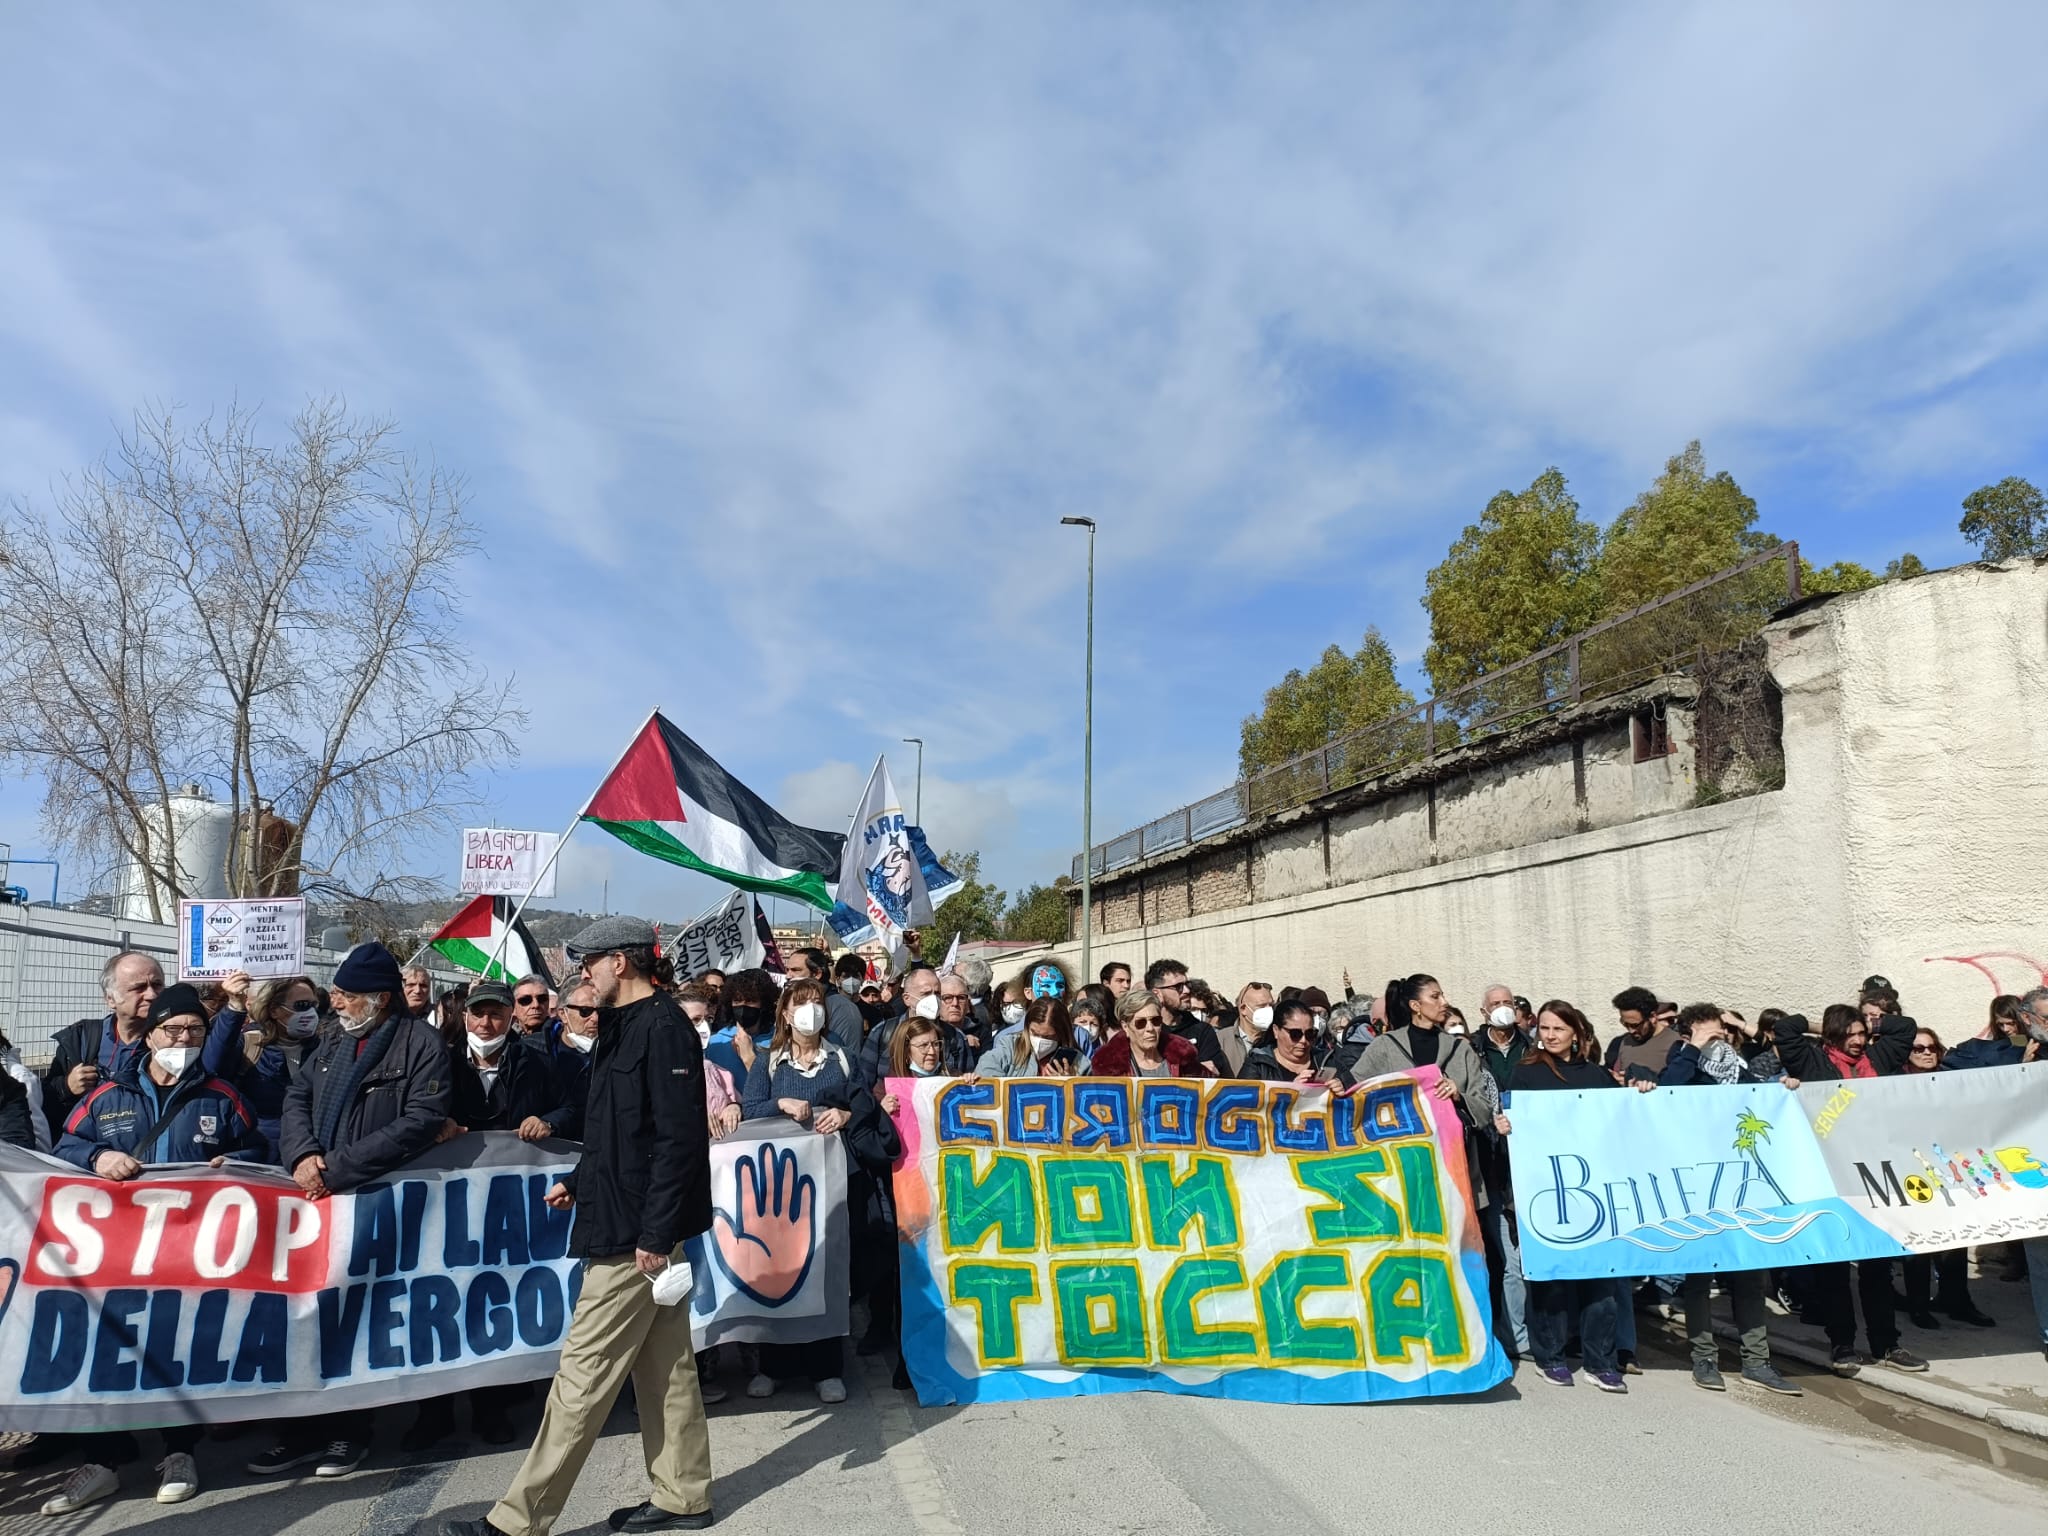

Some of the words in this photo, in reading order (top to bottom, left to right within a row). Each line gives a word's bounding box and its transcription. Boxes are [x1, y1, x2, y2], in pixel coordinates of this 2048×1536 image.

[466, 854, 514, 871] LIBERA
[468, 831, 536, 852] BAGNOLI
[245, 925, 287, 934] PAZZIATE
[250, 905, 284, 913] MENTRE
[244, 953, 296, 963] AVVELENATE
[248, 942, 289, 951] MURIMME
[935, 1078, 1433, 1155] COROGLIO
[1814, 1087, 1856, 1139] SENZA
[938, 1147, 1245, 1253] NON
[1290, 1142, 1449, 1246] SI
[1529, 1150, 1795, 1244] BELLEZZA
[36, 1186, 321, 1282] STOP
[348, 1180, 428, 1277] AI
[948, 1249, 1471, 1368] TOCCA
[20, 1289, 288, 1395] DELLA
